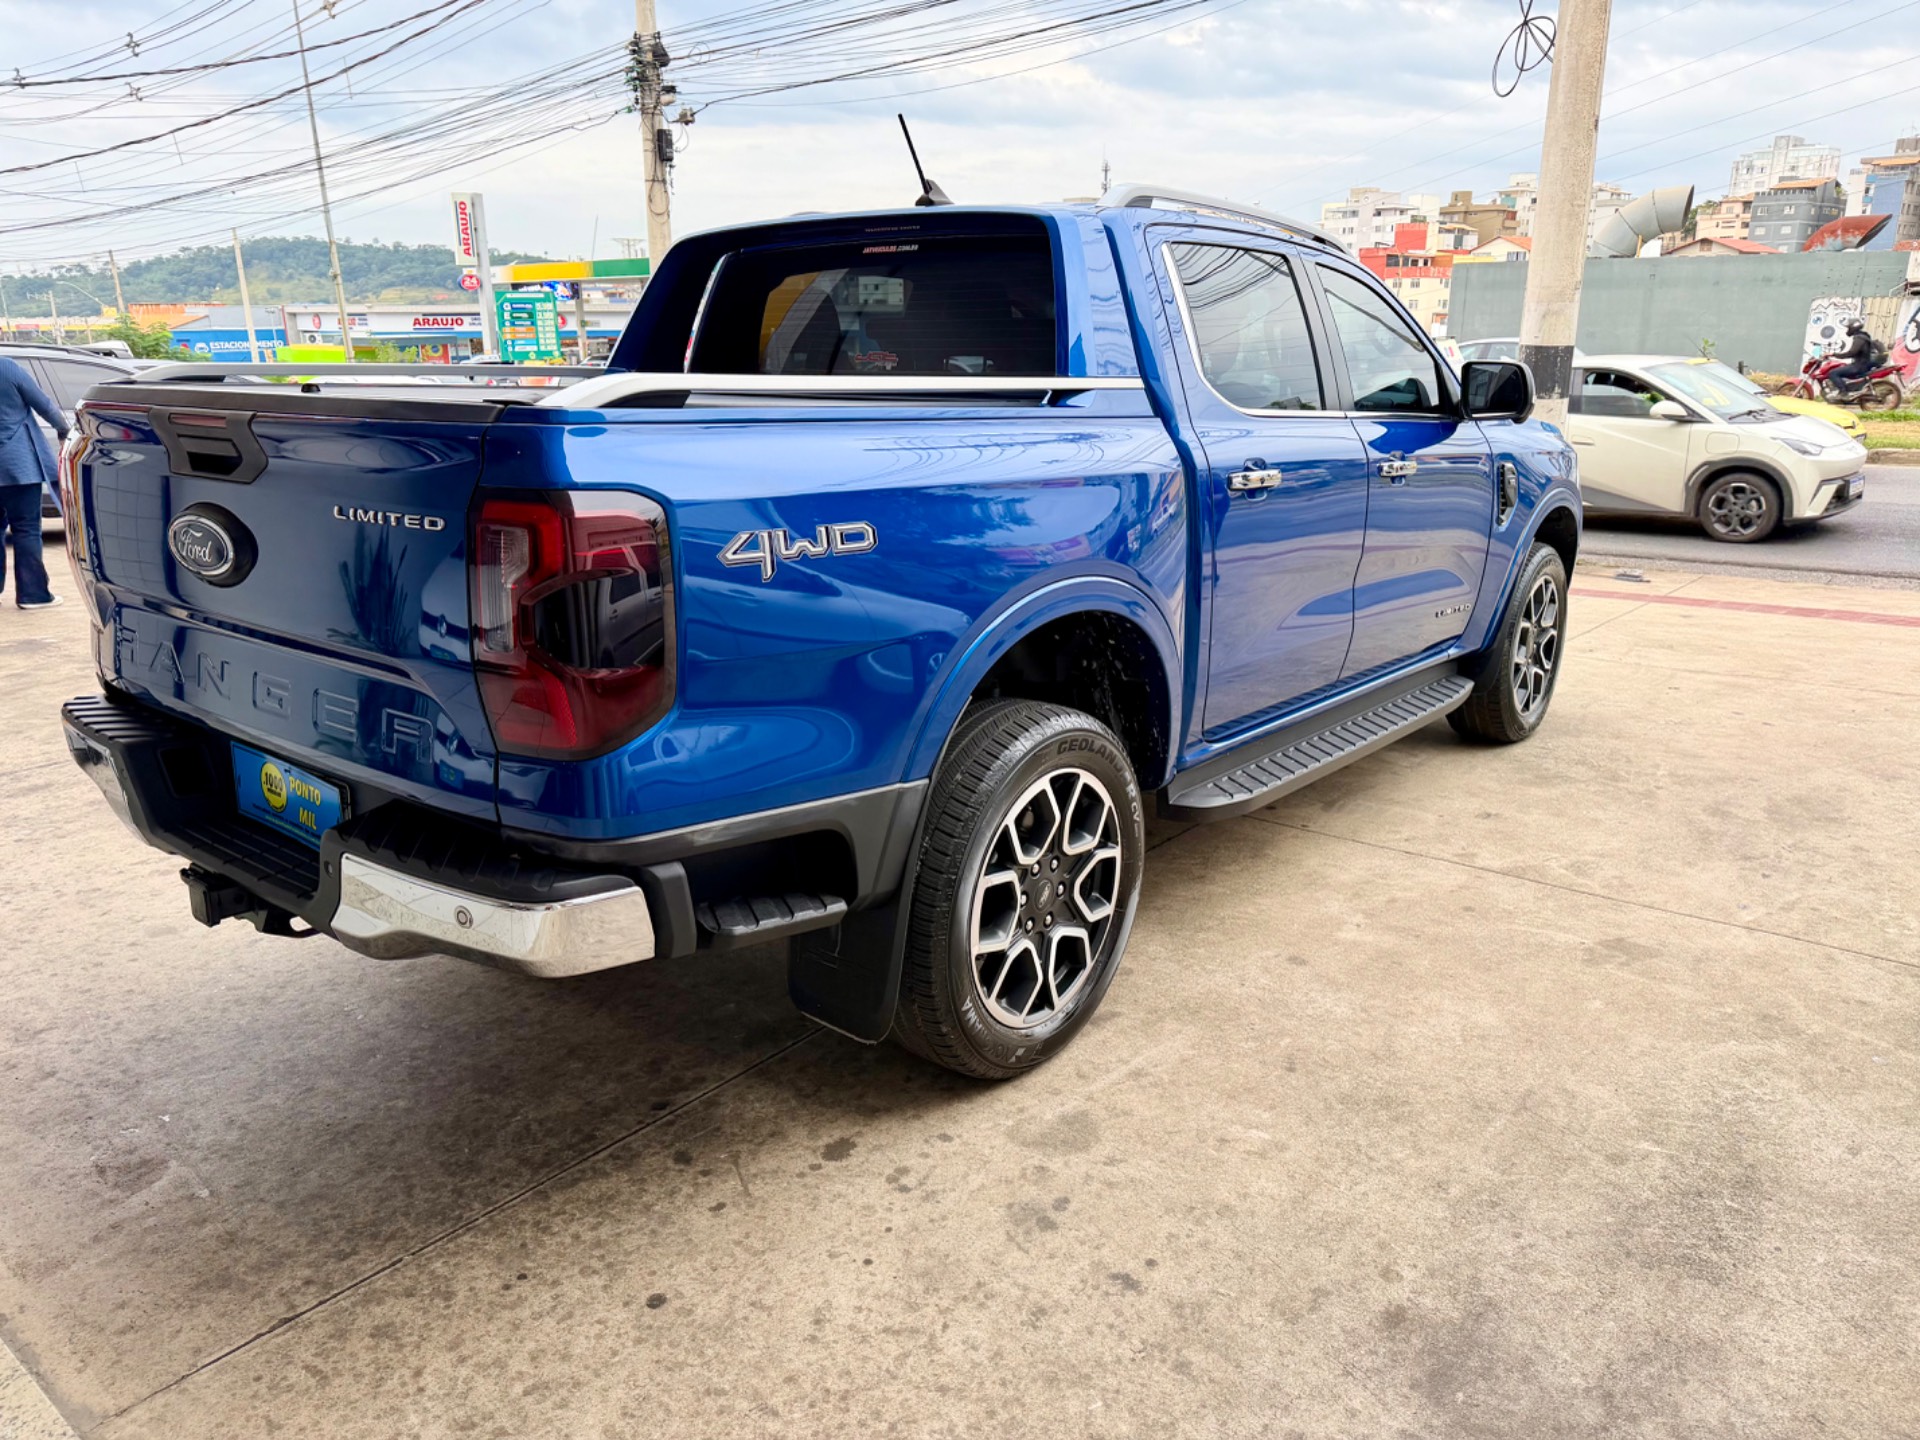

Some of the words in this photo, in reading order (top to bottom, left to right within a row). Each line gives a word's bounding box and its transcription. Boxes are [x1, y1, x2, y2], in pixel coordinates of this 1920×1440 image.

[458, 200, 472, 257] ARAUJO
[413, 317, 464, 327] ARAUJO
[333, 505, 445, 531] LIMITED
[178, 526, 213, 563] Ford
[717, 520, 878, 582] 4WD
[117, 622, 435, 764] RANGER
[289, 776, 321, 806] PONTO
[299, 806, 317, 831] MIL
